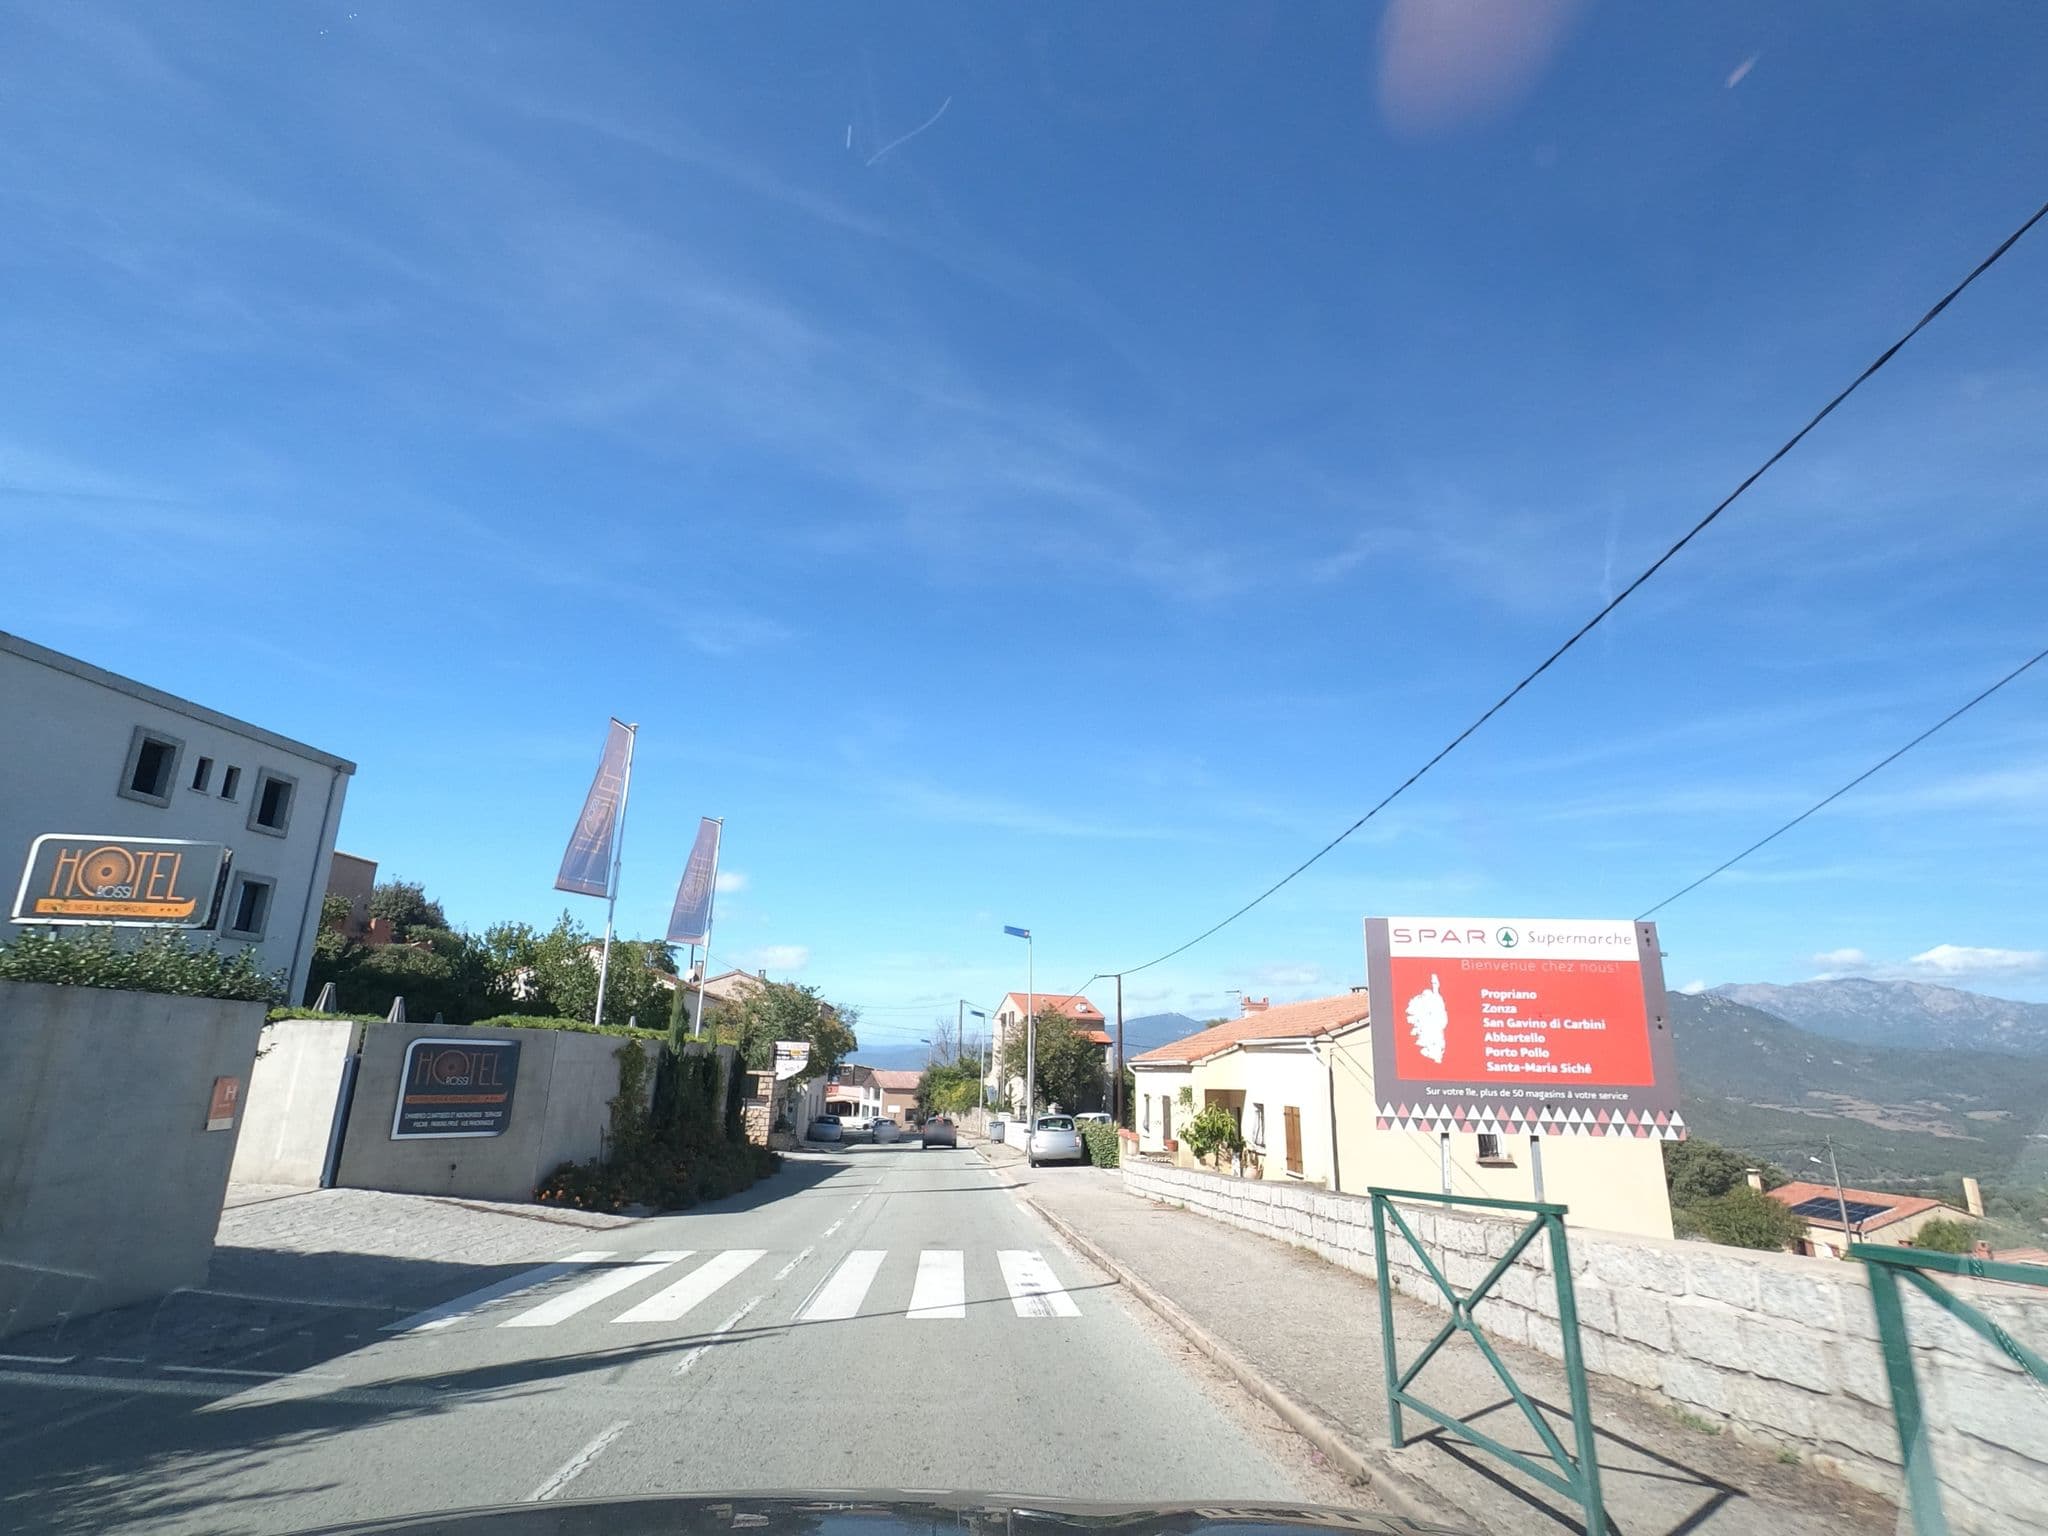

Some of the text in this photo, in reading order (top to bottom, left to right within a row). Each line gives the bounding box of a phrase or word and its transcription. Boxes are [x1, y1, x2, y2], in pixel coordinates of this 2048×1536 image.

[49, 846, 185, 900] HOTEL
[1393, 928, 1632, 948] SPAR Supermarche
[1461, 959, 1537, 972] Bienvenue
[1542, 961, 1575, 973] chez
[1480, 988, 1538, 1002] Propriano
[1482, 1003, 1518, 1014] Zonza
[1483, 1017, 1606, 1030] San Gavino di Carbini
[1484, 1032, 1546, 1043] Abbartello
[1485, 1046, 1550, 1058] Porto Pollo
[415, 1049, 503, 1086] HOTEL
[1486, 1061, 1558, 1073] Santa-Maria
[1425, 1087, 1440, 1096] Sur
[1442, 1088, 1464, 1096] votre
[1480, 1088, 1498, 1099] plus
[1500, 1088, 1511, 1097] de
[1512, 1089, 1524, 1098] 50
[1525, 1089, 1566, 1101] magasins
[1574, 1091, 1598, 1100] votre
[1598, 1091, 1630, 1100] service
